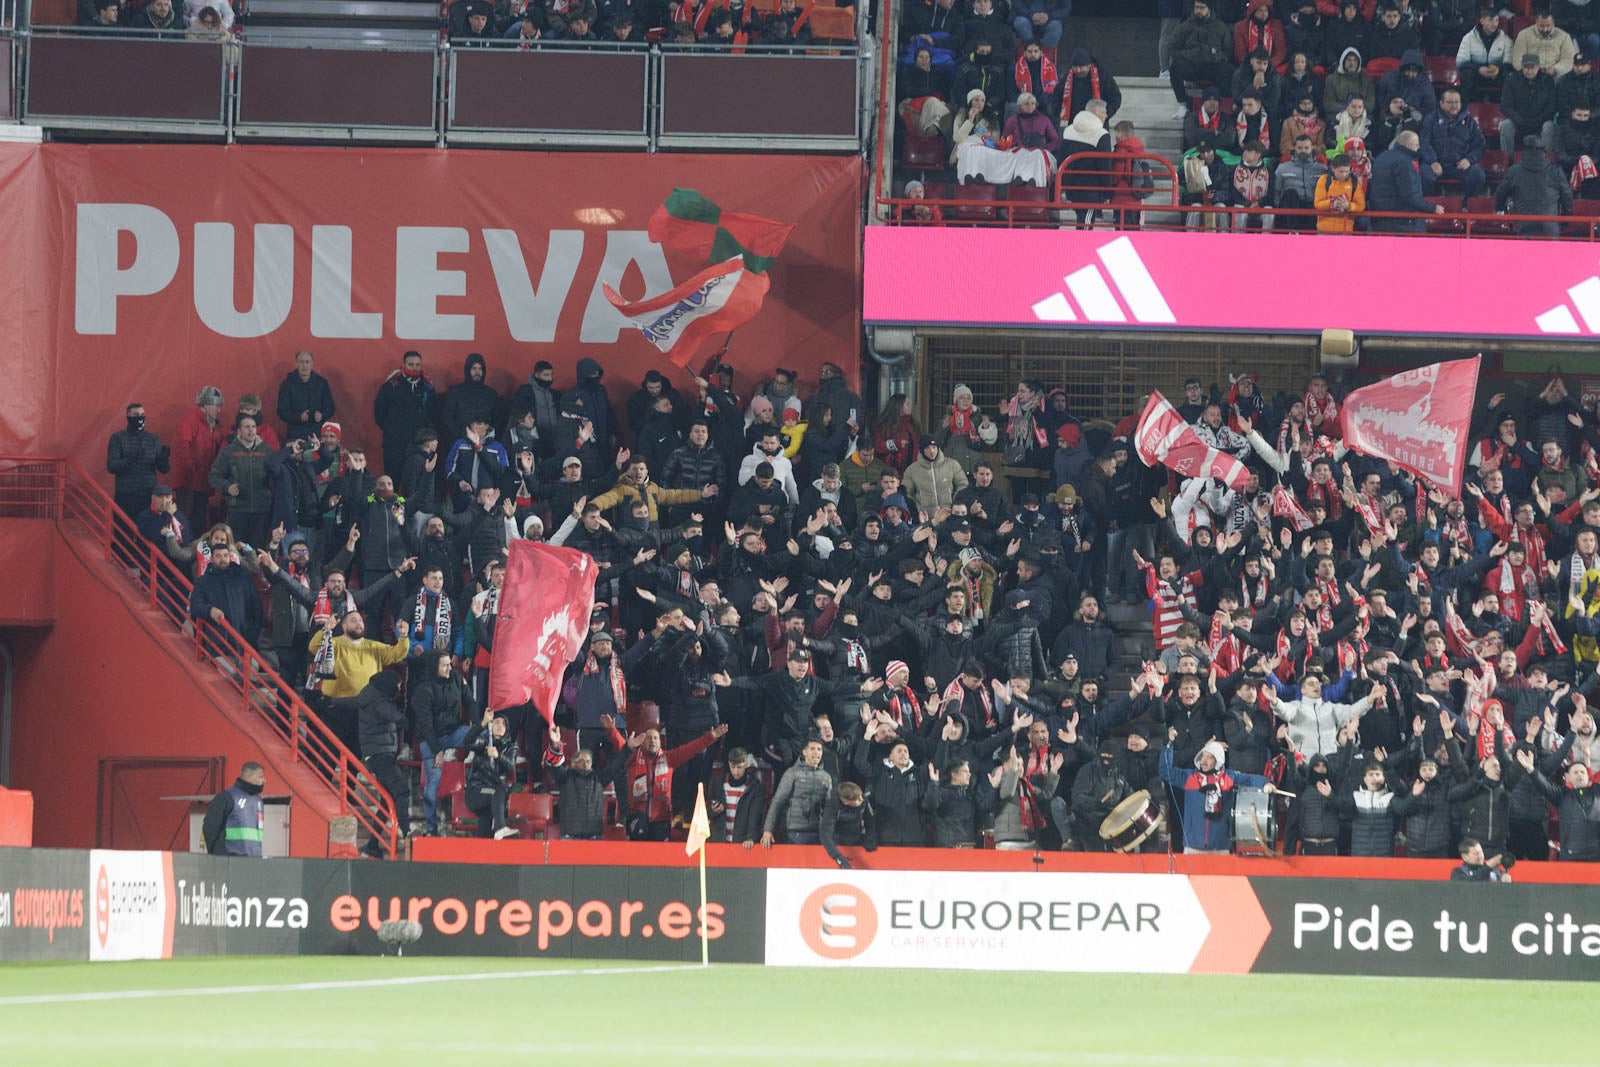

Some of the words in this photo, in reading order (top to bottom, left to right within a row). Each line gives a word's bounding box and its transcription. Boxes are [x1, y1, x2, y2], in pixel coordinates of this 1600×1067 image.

[75, 202, 677, 344] PULEVA
[14, 887, 84, 944] eurorepar.es
[178, 879, 190, 926] Tu
[330, 894, 725, 950] eurorepar.es
[890, 900, 1161, 932] EUROREPAR
[1294, 902, 1414, 952] Pide
[1433, 910, 1488, 954] tu
[1511, 912, 1600, 957] cita
[890, 935, 927, 948] CAR
[932, 936, 1009, 949] SERVICE
